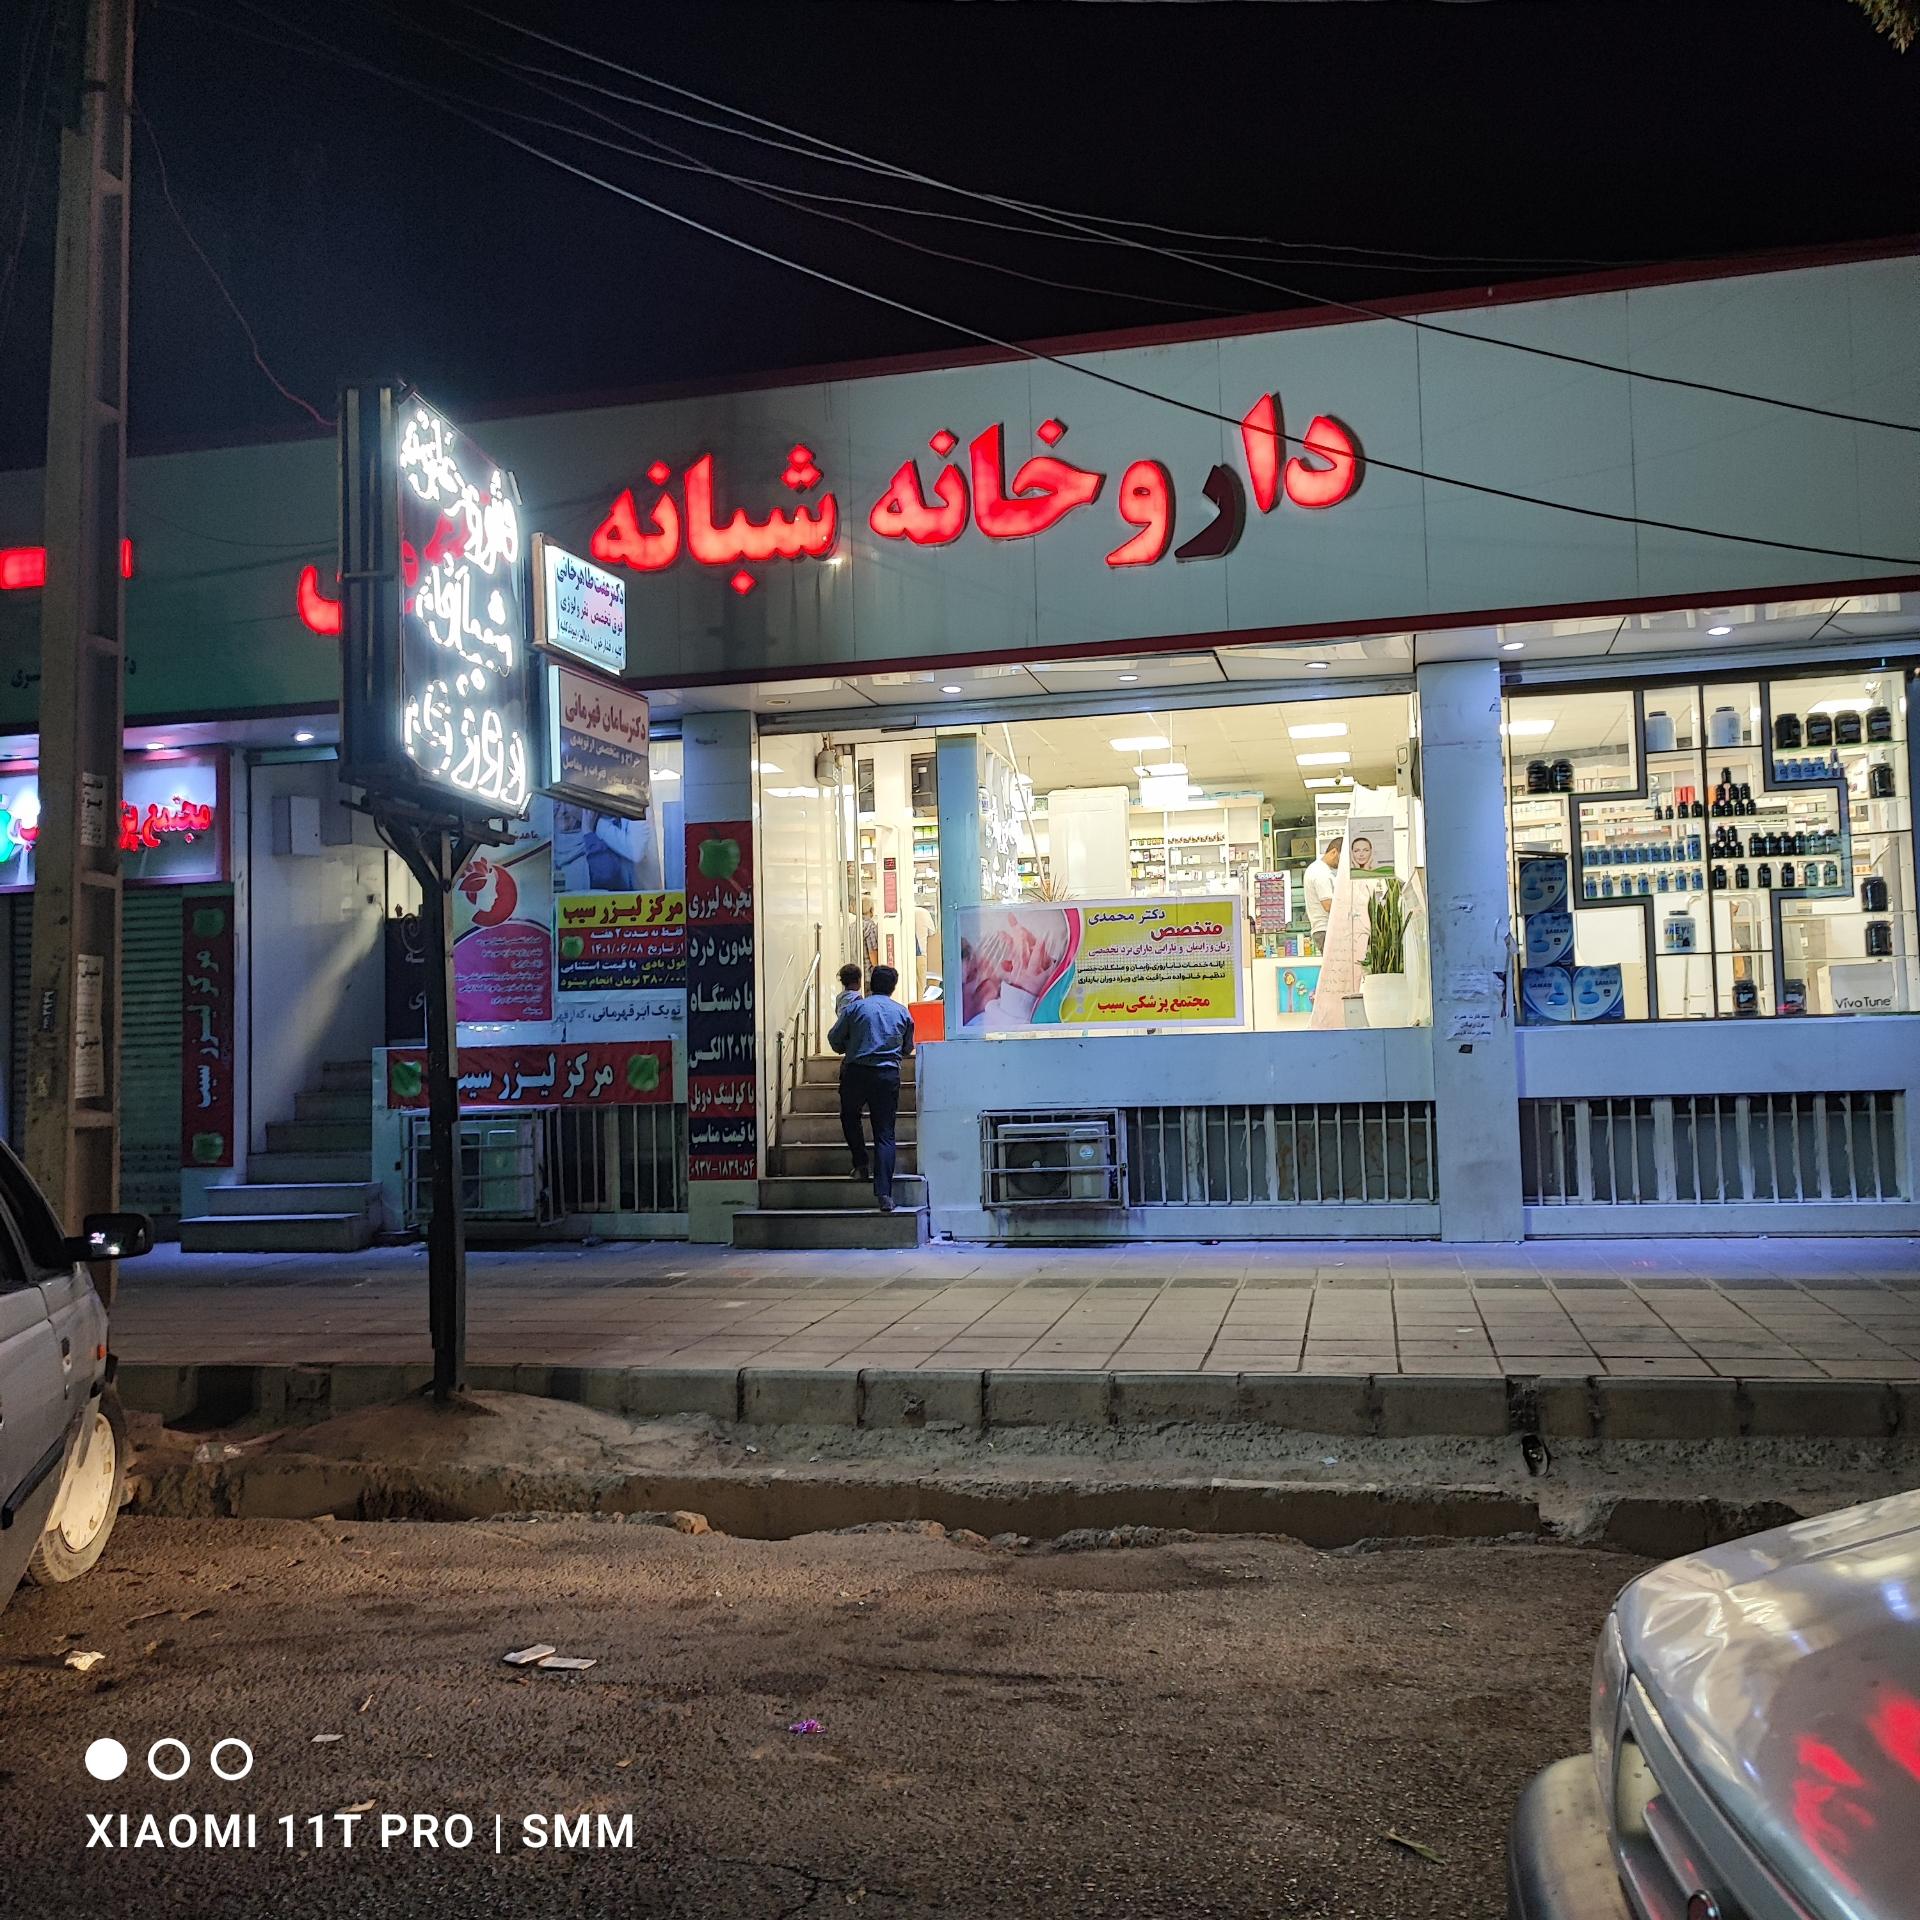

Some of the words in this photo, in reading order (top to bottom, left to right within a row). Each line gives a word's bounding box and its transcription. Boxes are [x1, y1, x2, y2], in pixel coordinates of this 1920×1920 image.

[869, 393, 1362, 568] داروخانه
[590, 443, 841, 595] شبانه
[608, 583, 624, 607] دکتر
[591, 610, 611, 625] تخصص
[611, 617, 623, 636] فوق
[565, 692, 601, 729] قهرمانی
[602, 706, 629, 733] سامان
[627, 716, 646, 743] دکتر
[563, 905, 597, 924] سیب
[600, 894, 643, 924] لیزر
[646, 894, 684, 923] مرکز
[688, 885, 720, 919] لیزری
[723, 885, 753, 918] تجربه
[1088, 911, 1136, 926] محمدی
[1138, 908, 1166, 924] دکتر
[590, 929, 614, 939] هفته
[623, 929, 649, 939] مدت
[660, 926, 684, 937] فقط
[1150, 920, 1223, 941] متخصص
[647, 942, 675, 955] تاریخ
[676, 942, 684, 955] از
[689, 936, 715, 966] درد
[718, 935, 753, 966] بدون
[602, 960, 627, 970] قیمت
[589, 977, 614, 988] انجام
[689, 982, 741, 1012] دستگاه
[743, 980, 753, 1018] با
[1097, 1001, 1125, 1013] سیب
[1126, 995, 1169, 1013] پزشکی
[1170, 995, 1210, 1011] مجتمع
[727, 1033, 755, 1062] ۲۰۲۲
[498, 1052, 557, 1100] لیزر
[563, 1052, 615, 1098] مرکز
[690, 1081, 712, 1113] دوبل
[747, 1081, 755, 1109] با
[691, 1122, 720, 1149] مناسب
[722, 1120, 746, 1148] قیمت
[747, 1121, 755, 1147] با
